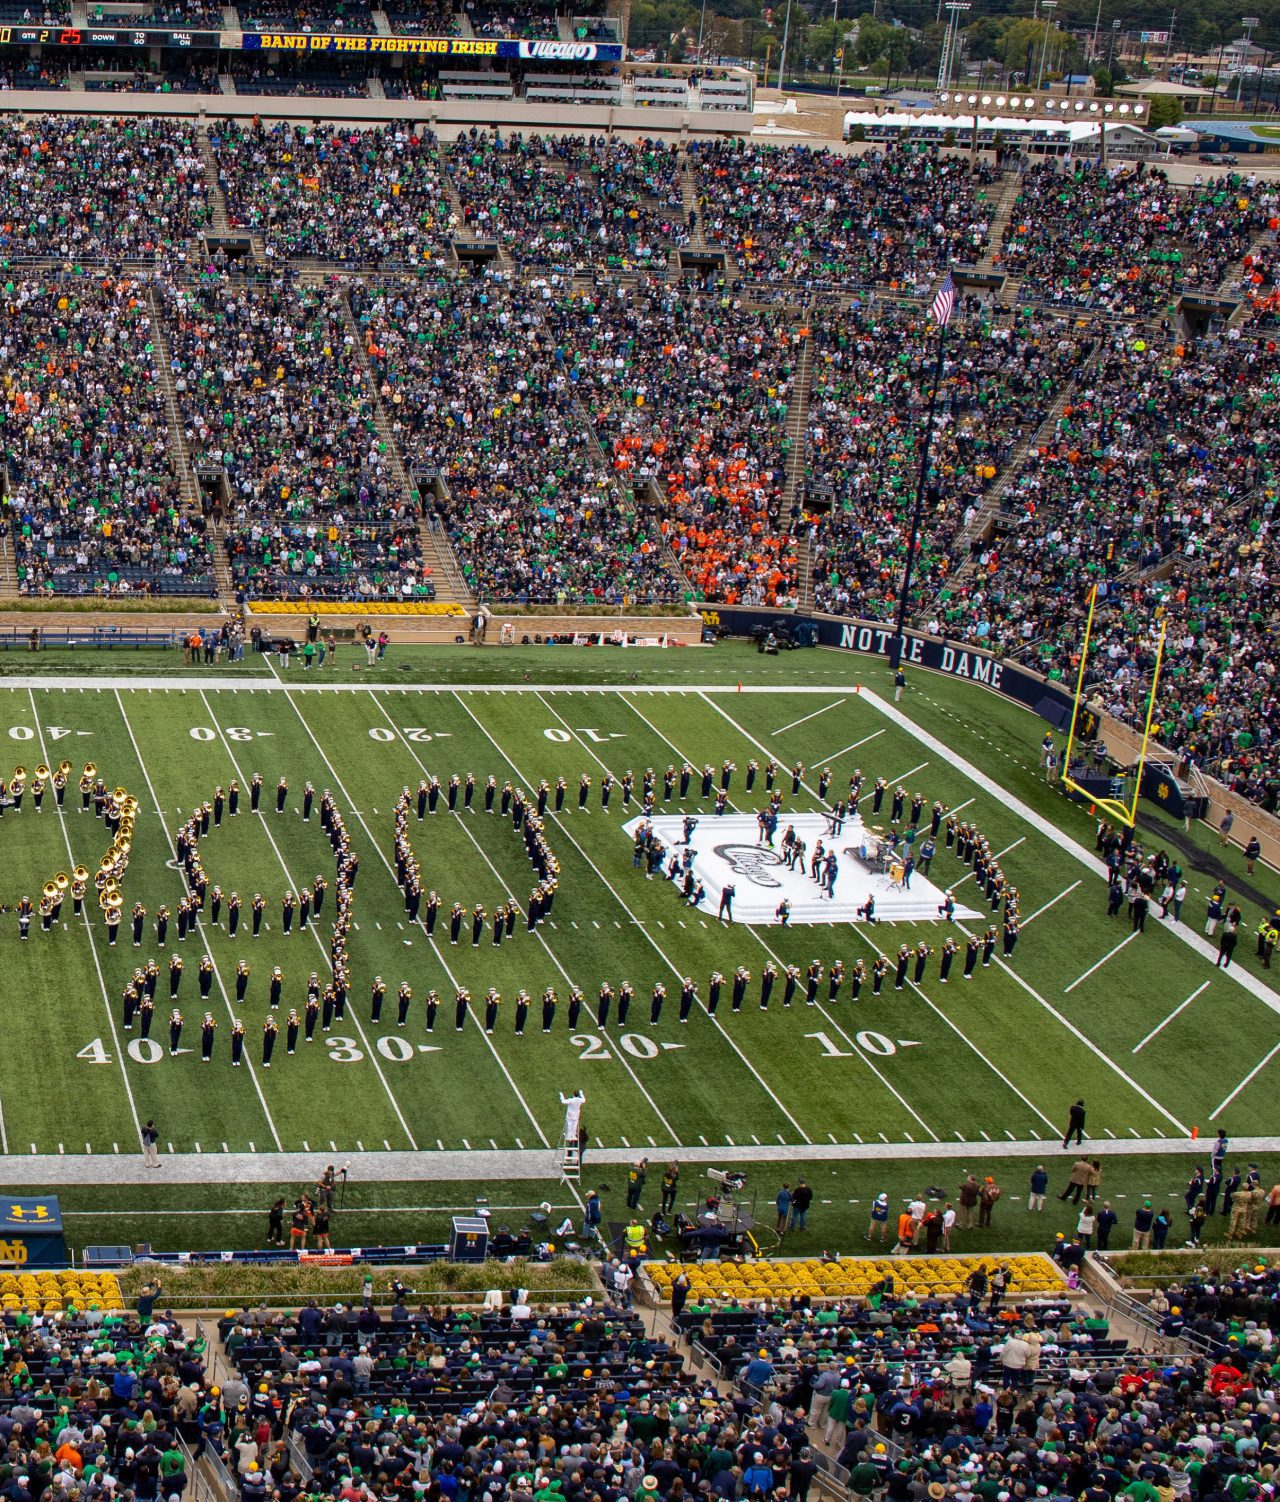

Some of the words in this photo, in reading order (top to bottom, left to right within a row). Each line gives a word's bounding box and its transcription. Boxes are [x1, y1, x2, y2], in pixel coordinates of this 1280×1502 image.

[40, 31, 49, 42] 2
[61, 31, 81, 44] 25
[261, 35, 307, 49] BAND
[310, 36, 332, 49] OF
[334, 37, 367, 50] THE
[370, 38, 448, 53] FIGHTING
[451, 41, 498, 54] IRISH
[940, 646, 1004, 689] DAME
[8, 726, 72, 741] 40
[189, 727, 254, 741] 30
[368, 727, 433, 742] 20
[76, 1037, 163, 1064] 40
[325, 1036, 414, 1062] 30
[569, 1033, 659, 1059] 20
[803, 1030, 897, 1057] 10
[900, 1413, 911, 1426] 3
